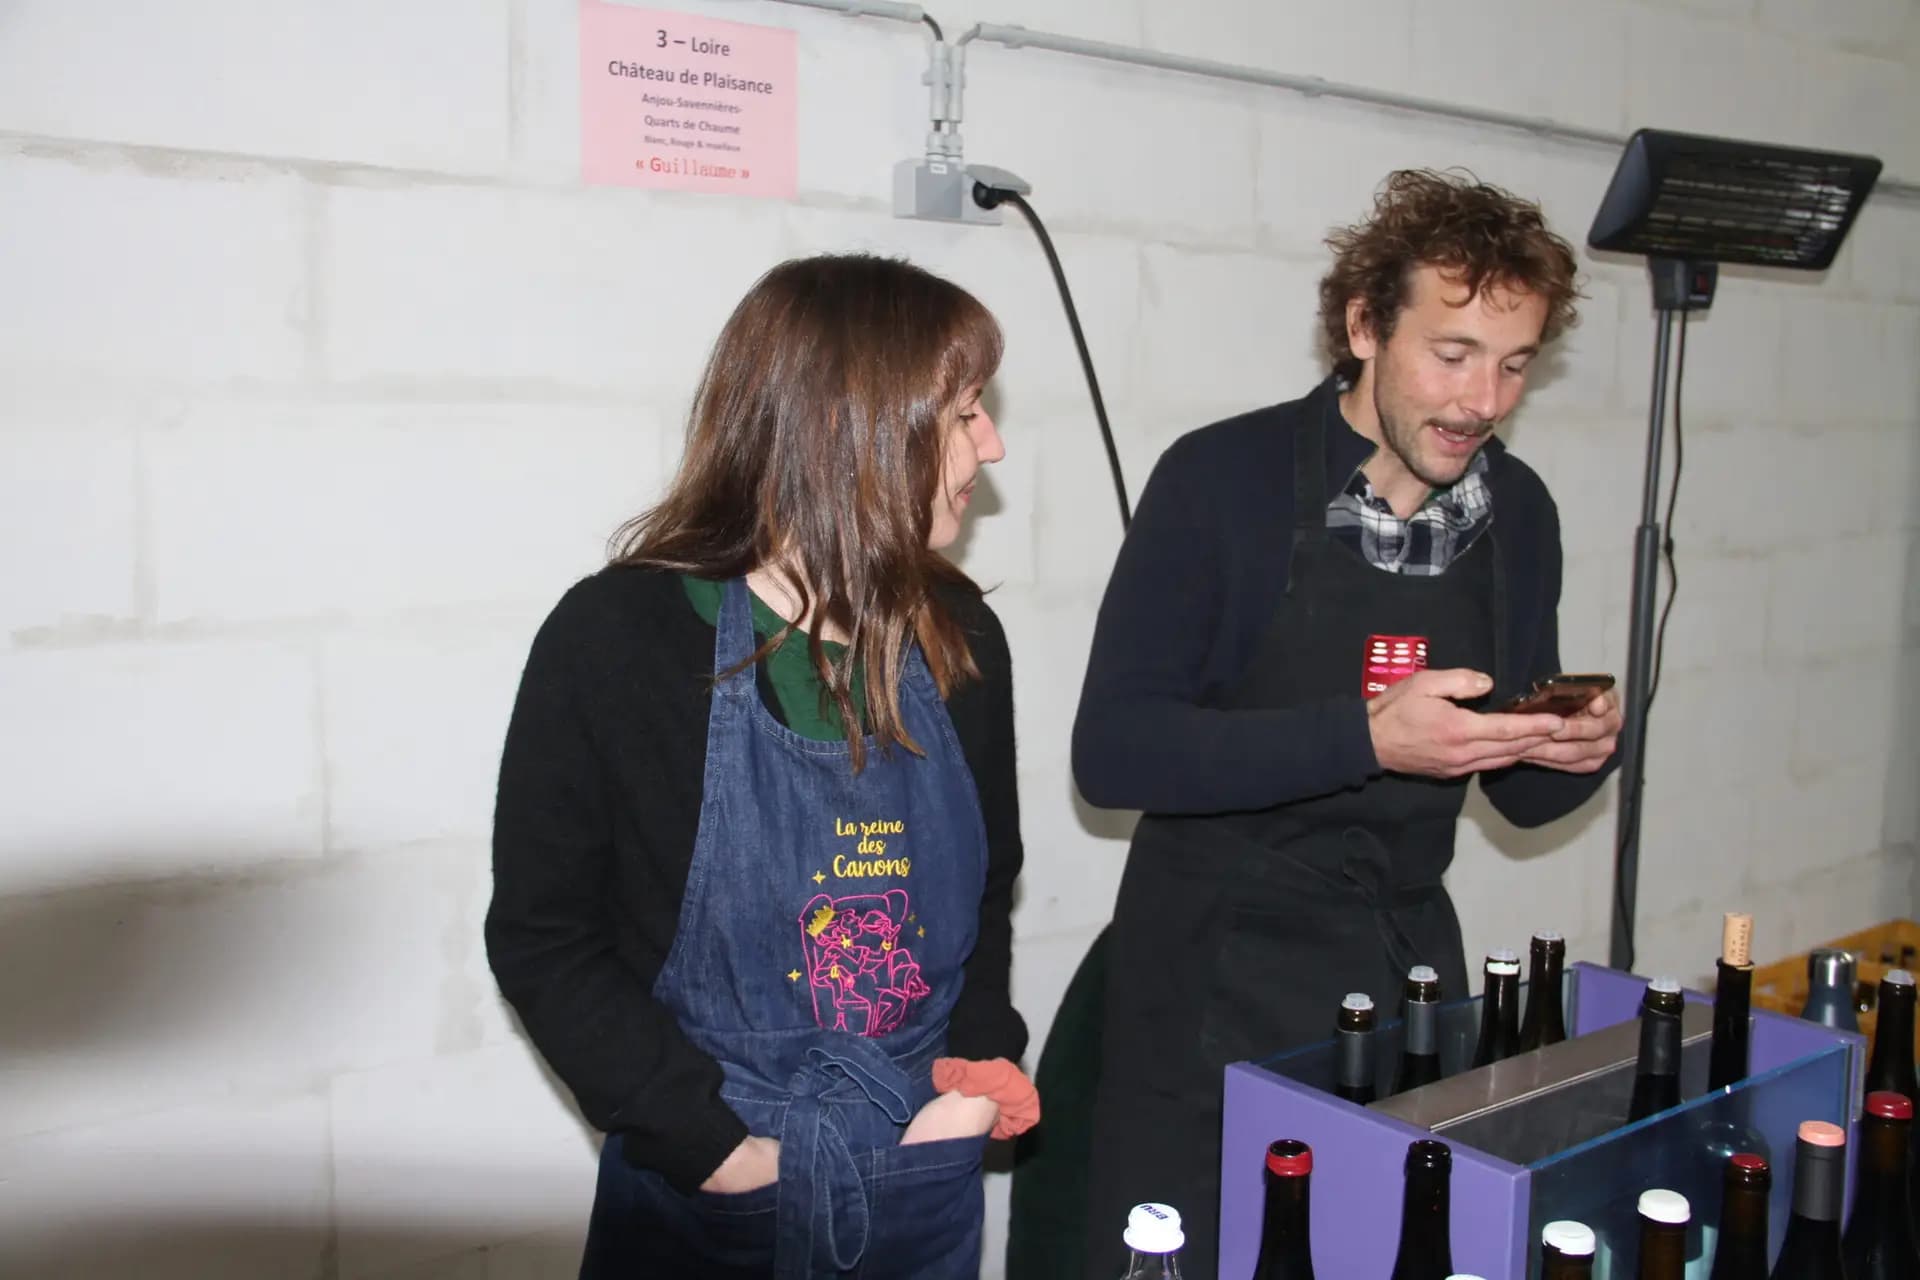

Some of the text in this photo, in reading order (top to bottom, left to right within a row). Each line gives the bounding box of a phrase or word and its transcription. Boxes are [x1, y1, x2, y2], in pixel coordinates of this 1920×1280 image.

[656, 30, 668, 48] 3
[691, 36, 731, 57] Loire
[608, 60, 774, 95] Château de Plaisance
[644, 114, 741, 134] Quarts de Chaume
[650, 156, 737, 178] Guillaume
[835, 818, 905, 836] La reine
[857, 835, 887, 855] des
[833, 854, 912, 880] Canons
